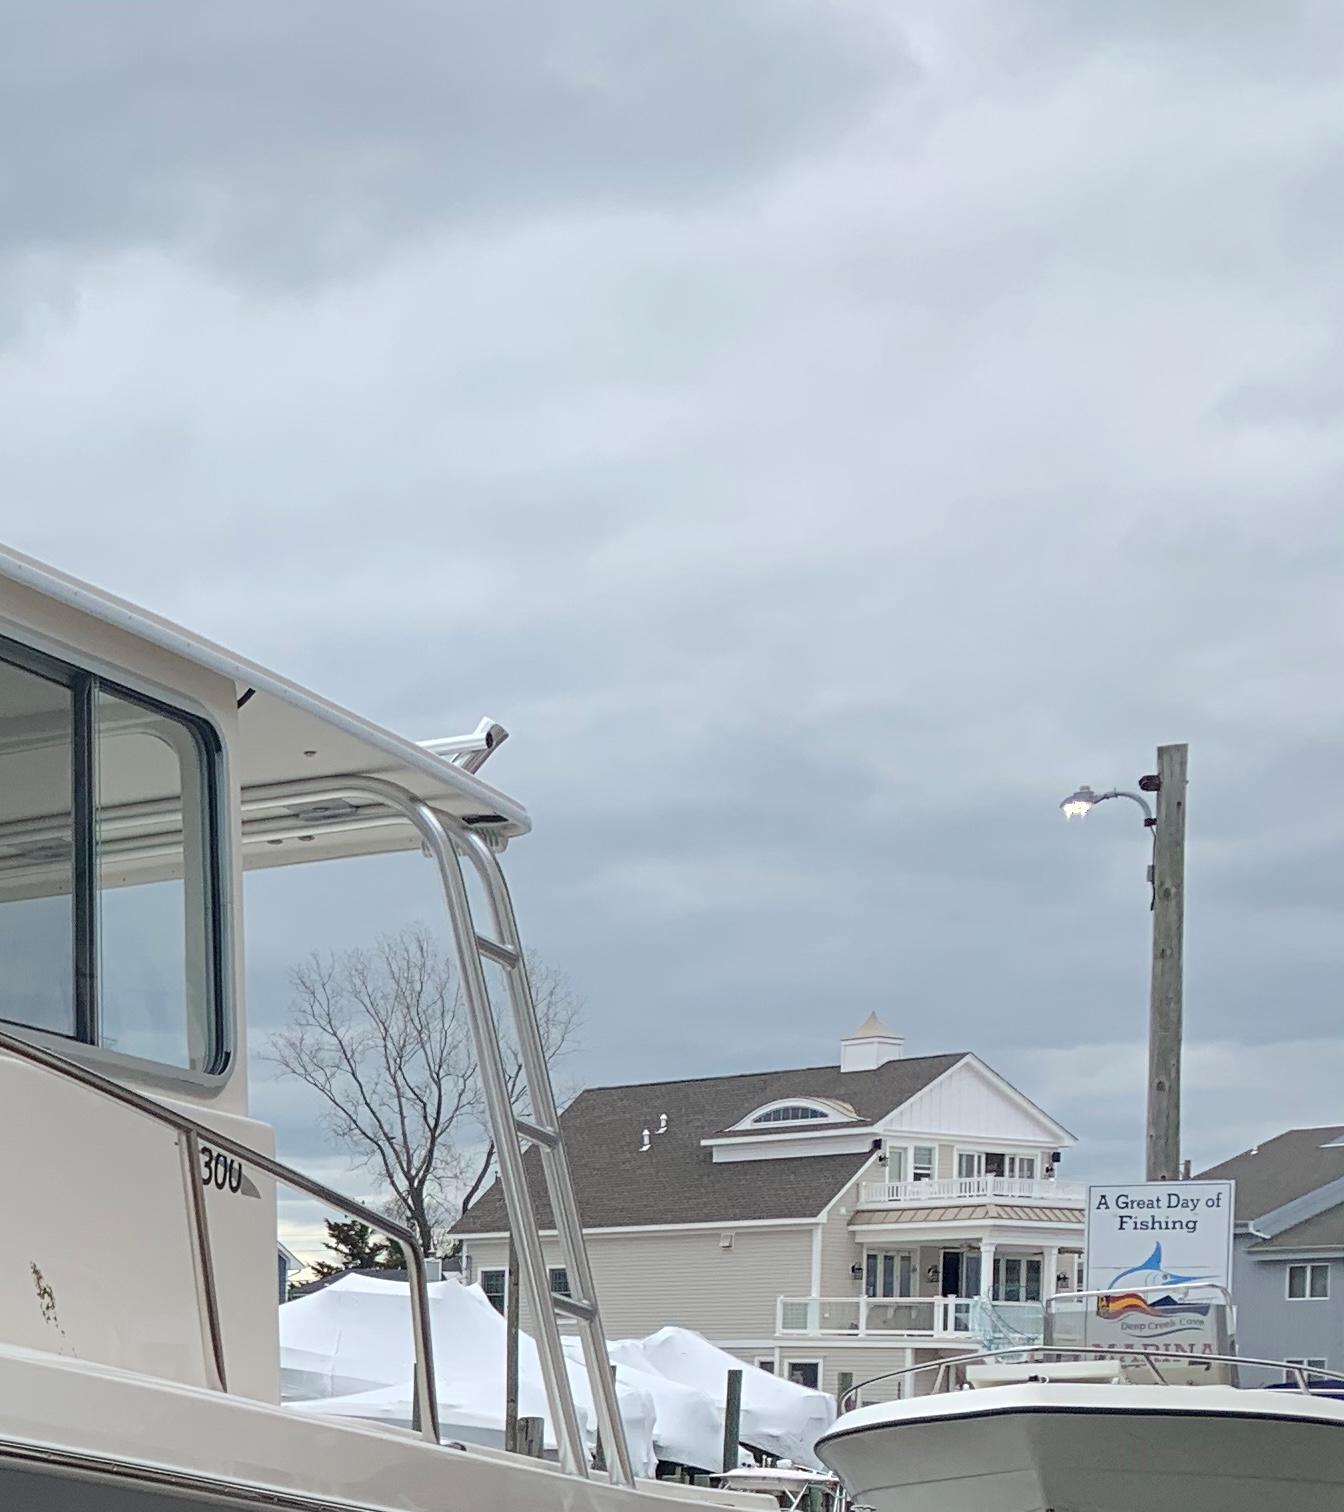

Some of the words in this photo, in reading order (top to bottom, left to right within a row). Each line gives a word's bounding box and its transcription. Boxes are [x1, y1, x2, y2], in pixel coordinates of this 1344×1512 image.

[1096, 1194, 1110, 1210] A
[1115, 1194, 1162, 1210] Great
[1166, 1193, 1201, 1212] Day
[1205, 1192, 1223, 1208] of
[1117, 1215, 1199, 1233] Fishing
[1120, 1321, 1146, 1332] Deep
[1148, 1319, 1176, 1331] Creek
